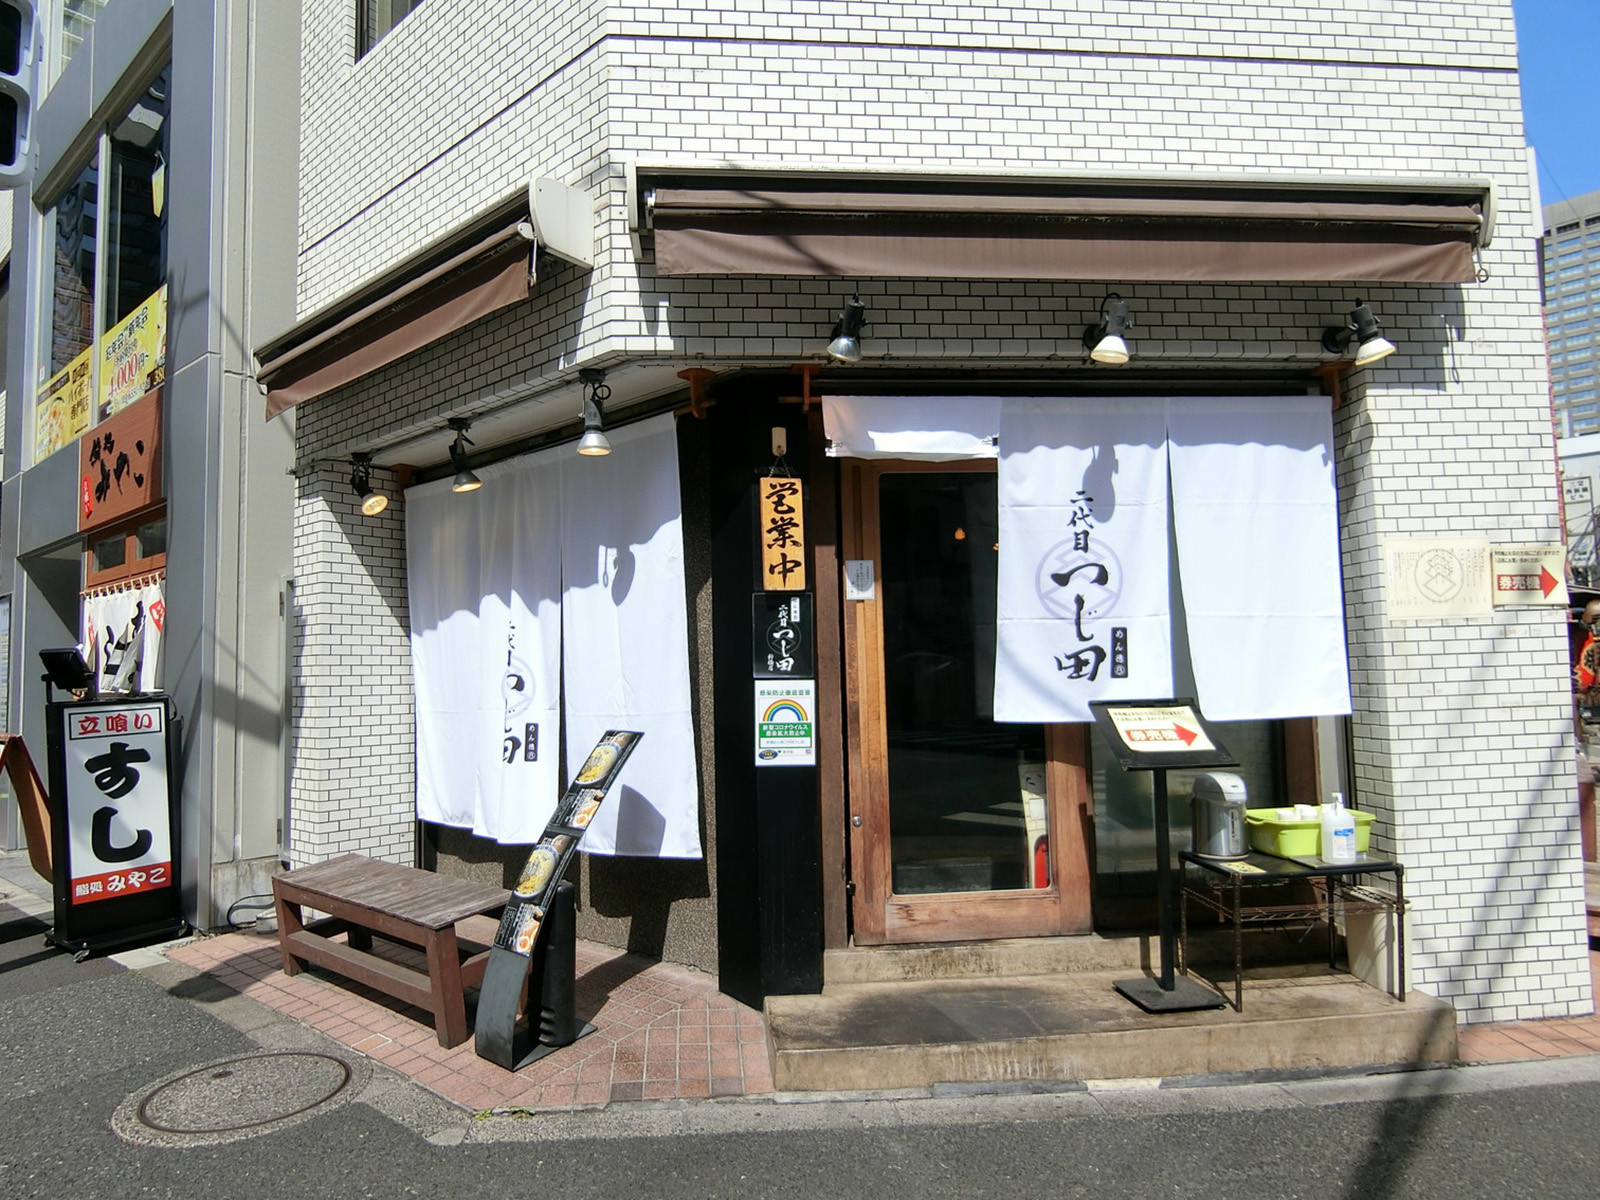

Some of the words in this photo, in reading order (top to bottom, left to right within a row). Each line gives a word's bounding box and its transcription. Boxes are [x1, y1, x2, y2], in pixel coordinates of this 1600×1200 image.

[766, 481, 803, 589] 営業中
[1499, 574, 1539, 590] 券売機
[78, 713, 153, 735] 立喰い
[84, 742, 151, 863] すし
